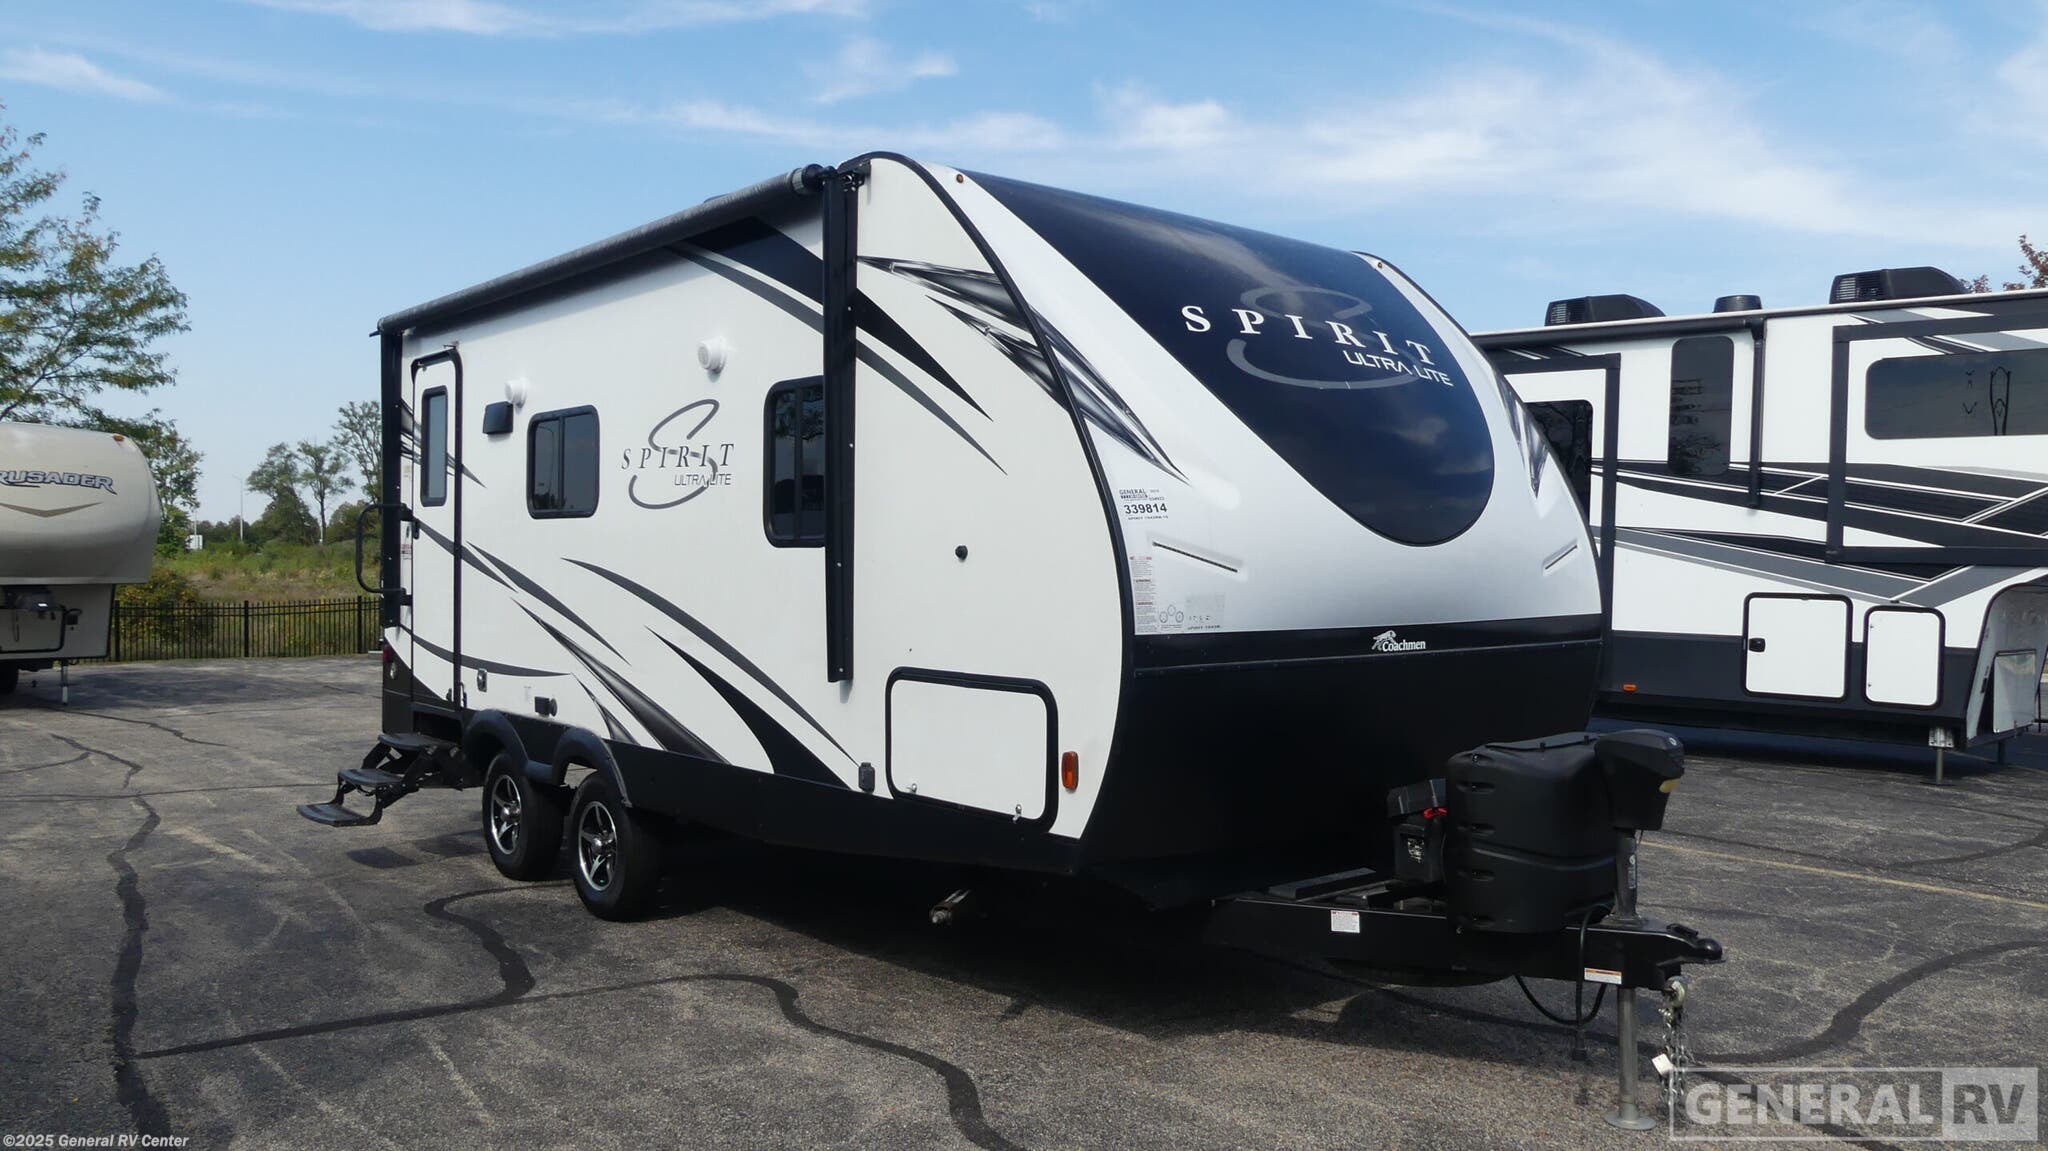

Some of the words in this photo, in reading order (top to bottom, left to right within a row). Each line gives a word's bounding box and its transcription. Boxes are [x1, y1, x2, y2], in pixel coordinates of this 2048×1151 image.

[1181, 305, 1435, 365] SPIRIT
[1343, 350, 1413, 375] ULTRA
[1412, 364, 1454, 387] LITE
[620, 443, 735, 470] SPIRIT
[674, 474, 707, 486] ULTRA
[709, 473, 732, 486] LITE
[1123, 502, 1168, 515] 339814
[1382, 639, 1426, 652] Coachmen
